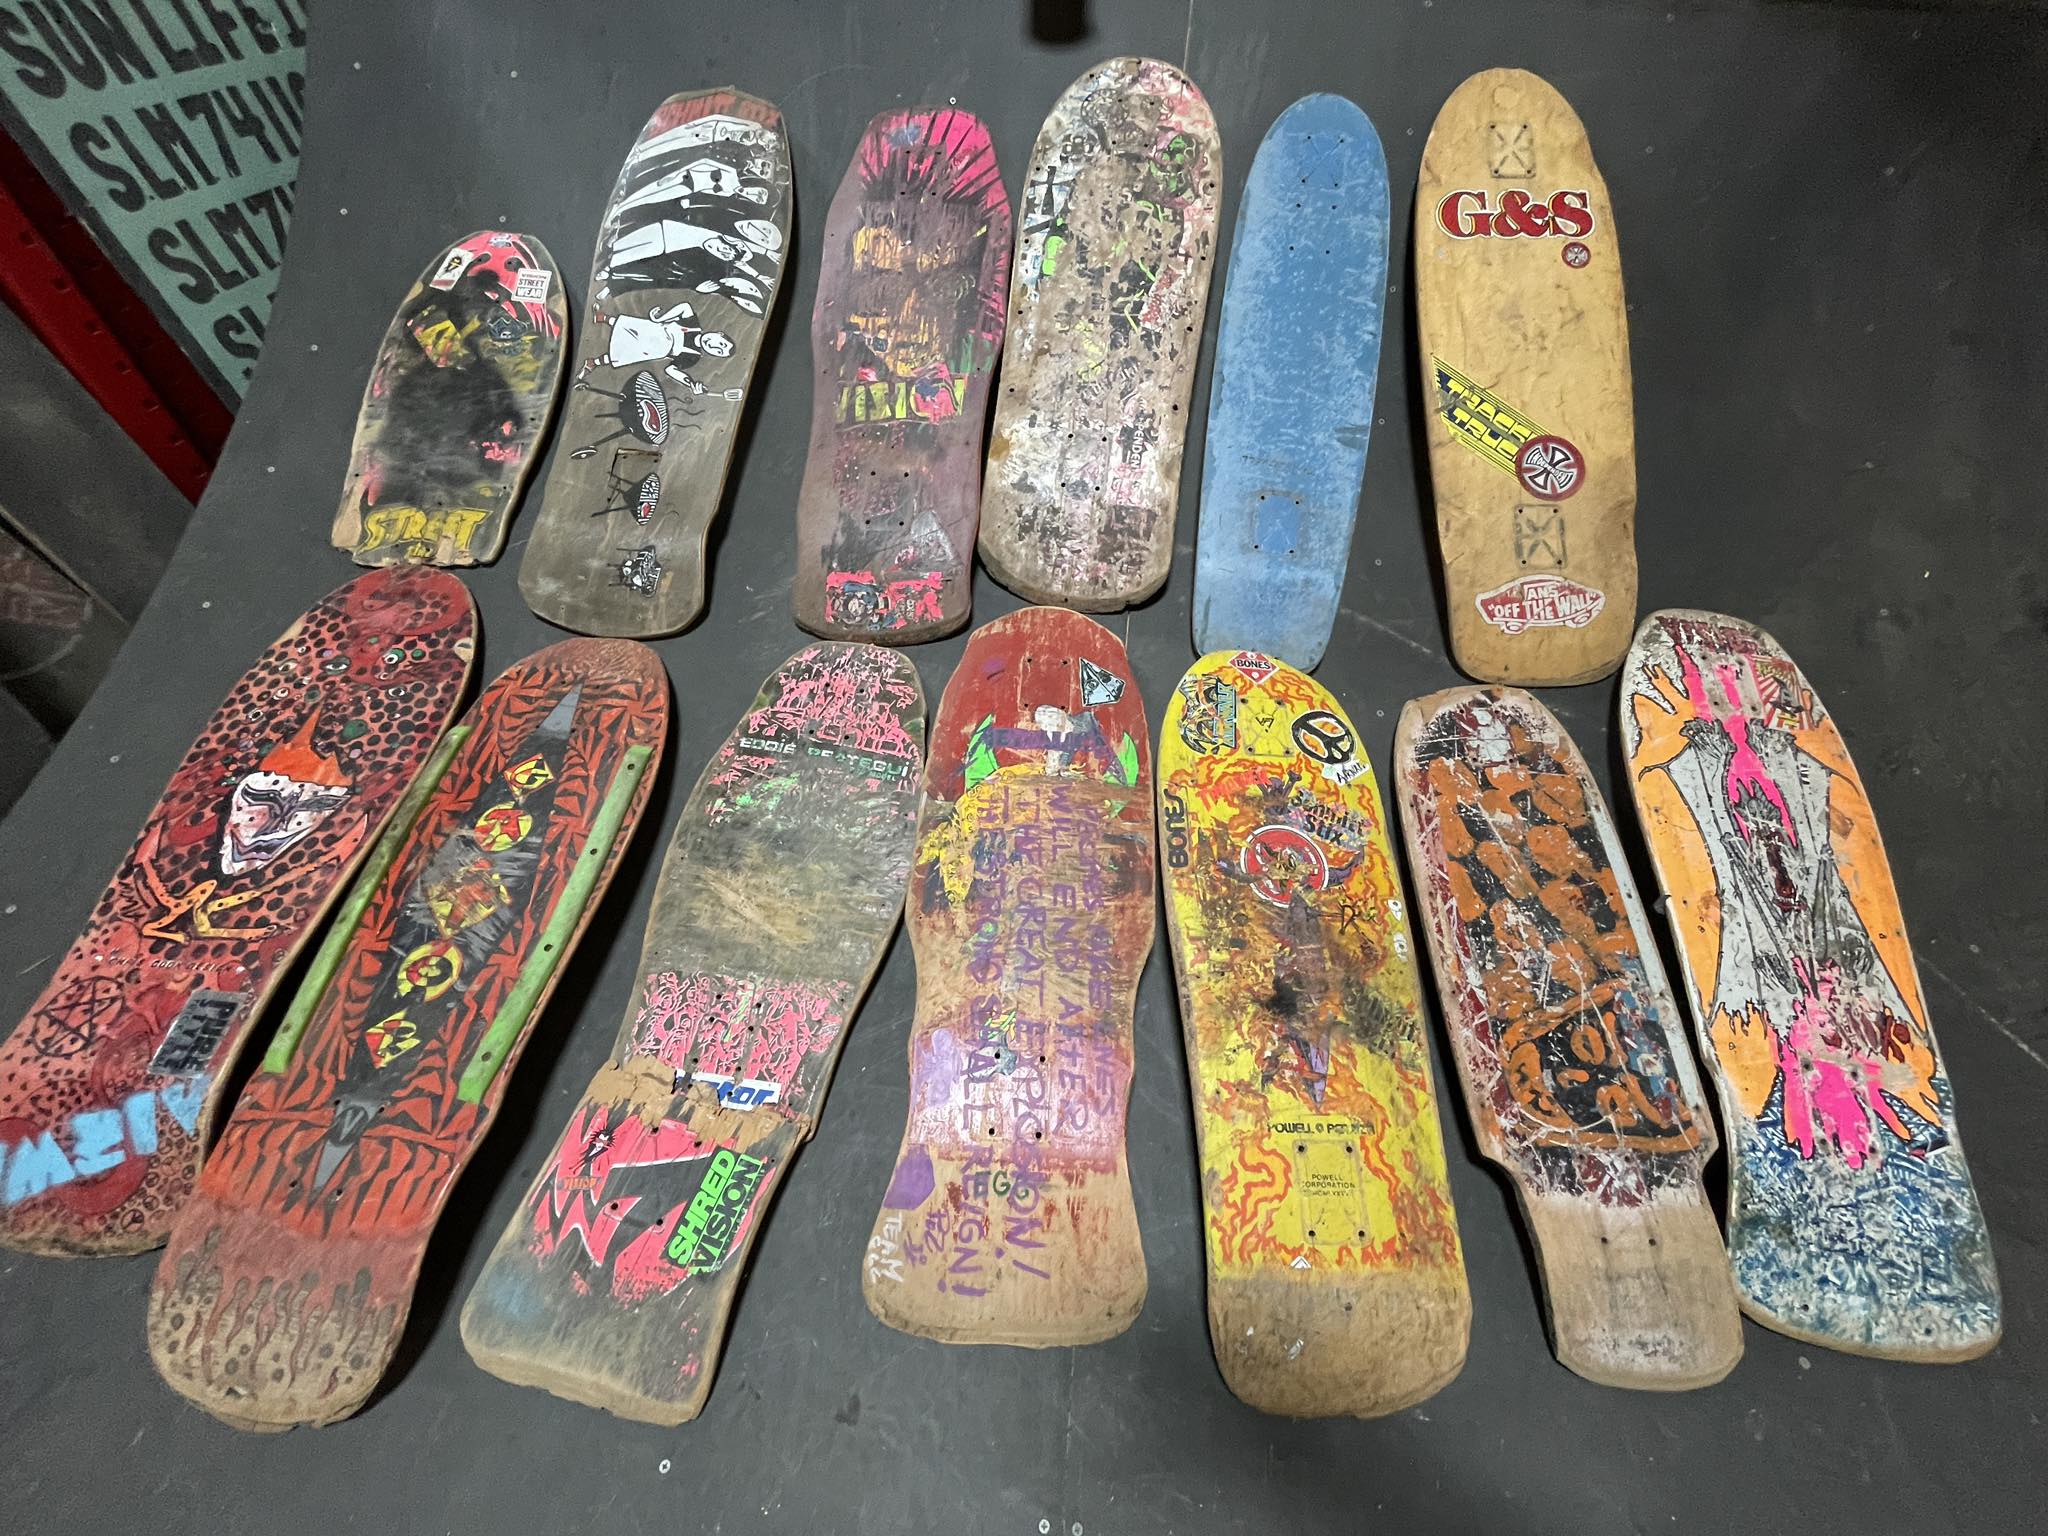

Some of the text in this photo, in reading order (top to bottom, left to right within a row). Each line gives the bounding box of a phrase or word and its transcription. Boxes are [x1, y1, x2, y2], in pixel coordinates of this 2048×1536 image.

[1438, 189, 1595, 239] G&S
[518, 278, 545, 288] STREET
[1522, 597, 1555, 621] THE
[1236, 658, 1271, 671] BONES
[1052, 884, 1079, 972] END
[668, 1150, 735, 1266] SHRED
[691, 1154, 763, 1272] VISION
